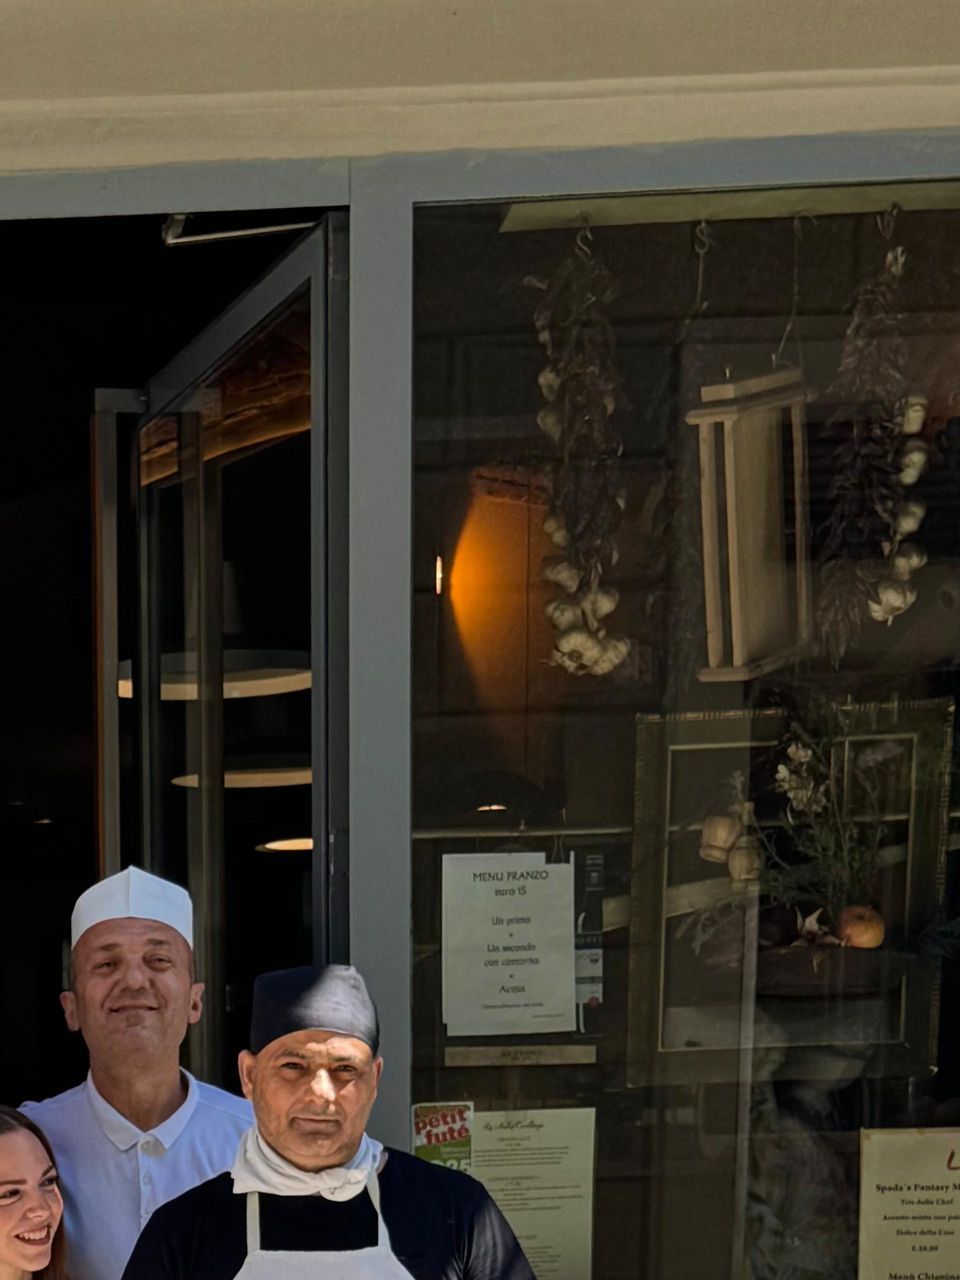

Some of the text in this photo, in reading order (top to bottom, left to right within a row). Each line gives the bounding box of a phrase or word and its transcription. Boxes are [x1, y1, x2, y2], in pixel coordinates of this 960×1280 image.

[473, 870, 549, 882] MENU PRANZO
[492, 916, 504, 925] Un
[415, 1106, 467, 1135] petit
[424, 1122, 470, 1146] futé
